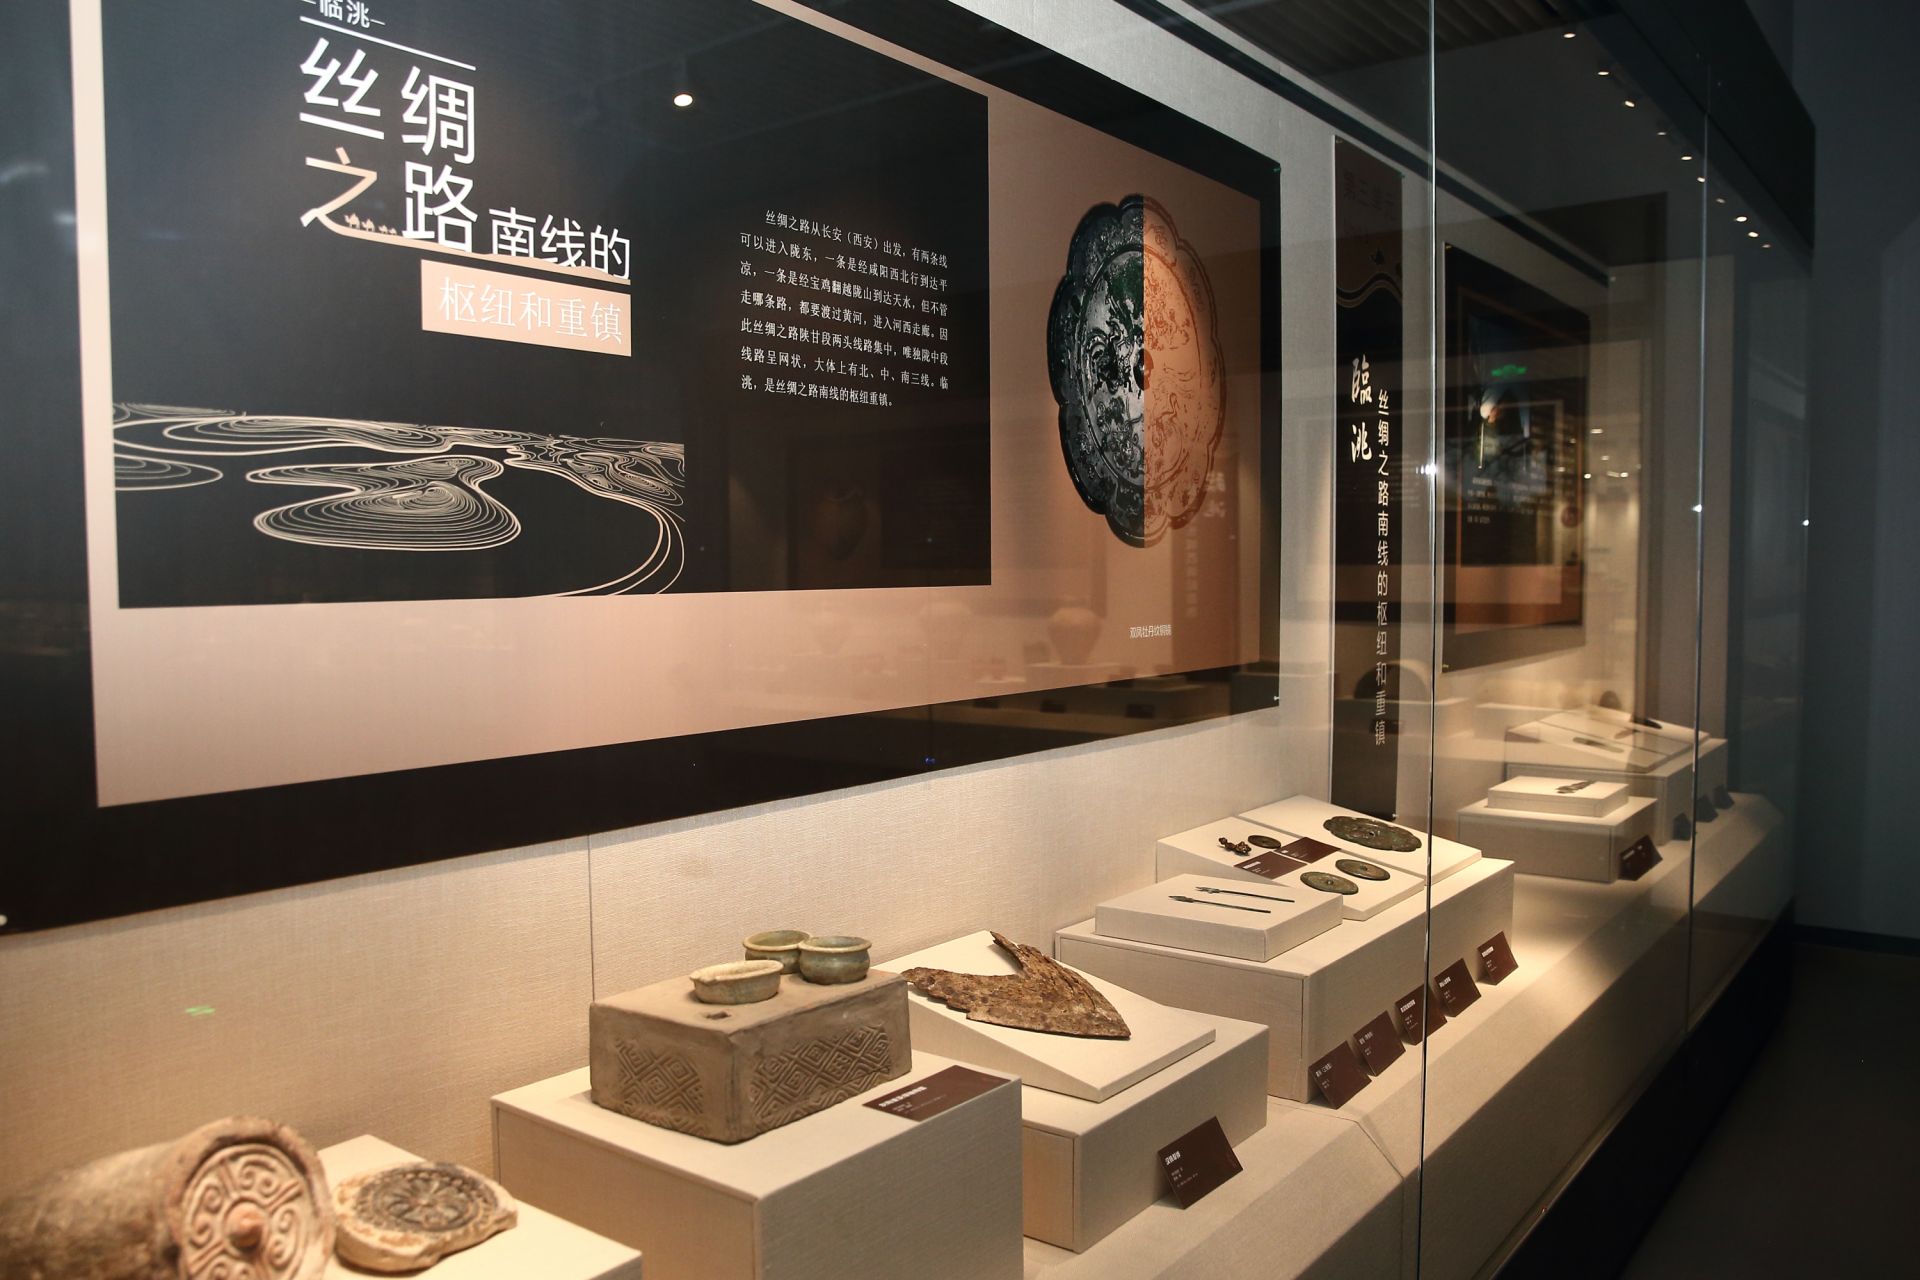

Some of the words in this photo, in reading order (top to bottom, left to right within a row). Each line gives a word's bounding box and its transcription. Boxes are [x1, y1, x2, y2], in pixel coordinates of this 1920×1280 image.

[300, 37, 476, 165] 丝绸
[439, 276, 622, 345] 枢纽和重镇
[1375, 388, 1390, 746] 丝绸之路南线的枢纽和重镇
